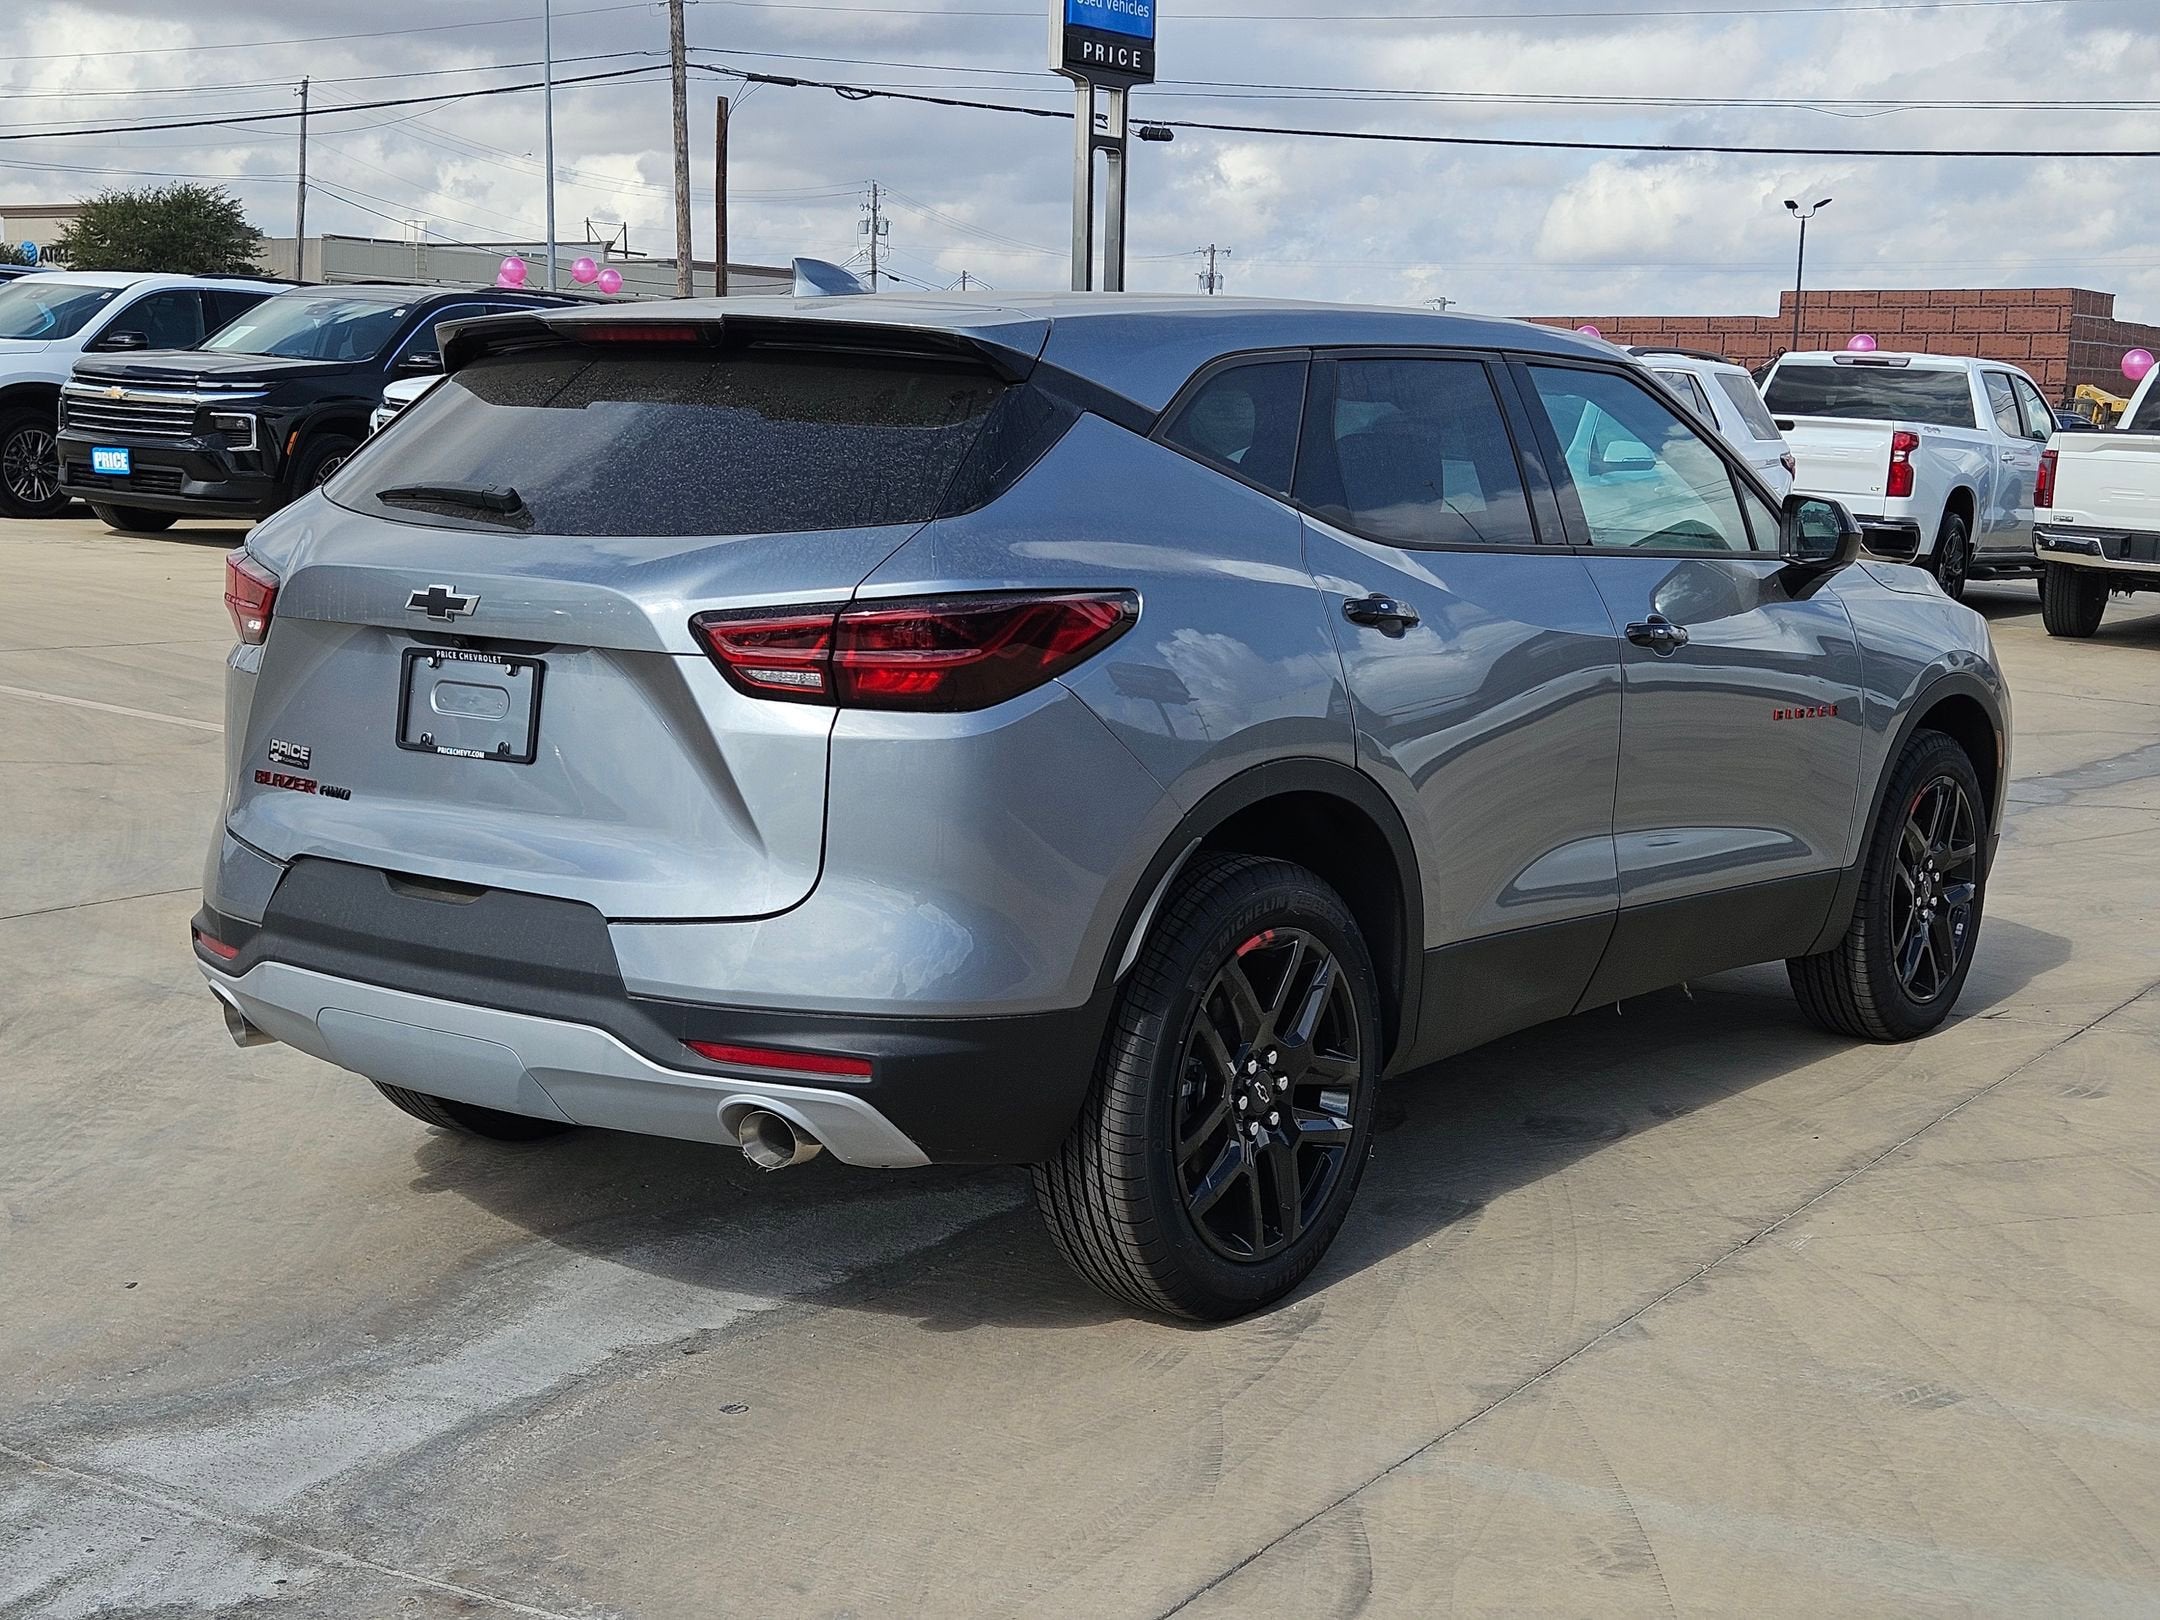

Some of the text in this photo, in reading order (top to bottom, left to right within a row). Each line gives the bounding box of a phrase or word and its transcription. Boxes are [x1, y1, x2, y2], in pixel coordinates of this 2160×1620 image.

[1077, 0, 1150, 18] ed Vehicles
[1083, 41, 1141, 68] PRICE
[95, 451, 128, 469] PRICE
[436, 650, 502, 664] PRICE CHEVROLET
[270, 738, 310, 761] PRICE
[437, 746, 485, 759] PRICECHEVY.COM
[254, 769, 351, 800] BLAZER AWD
[1219, 895, 1289, 951] MICHELIN
